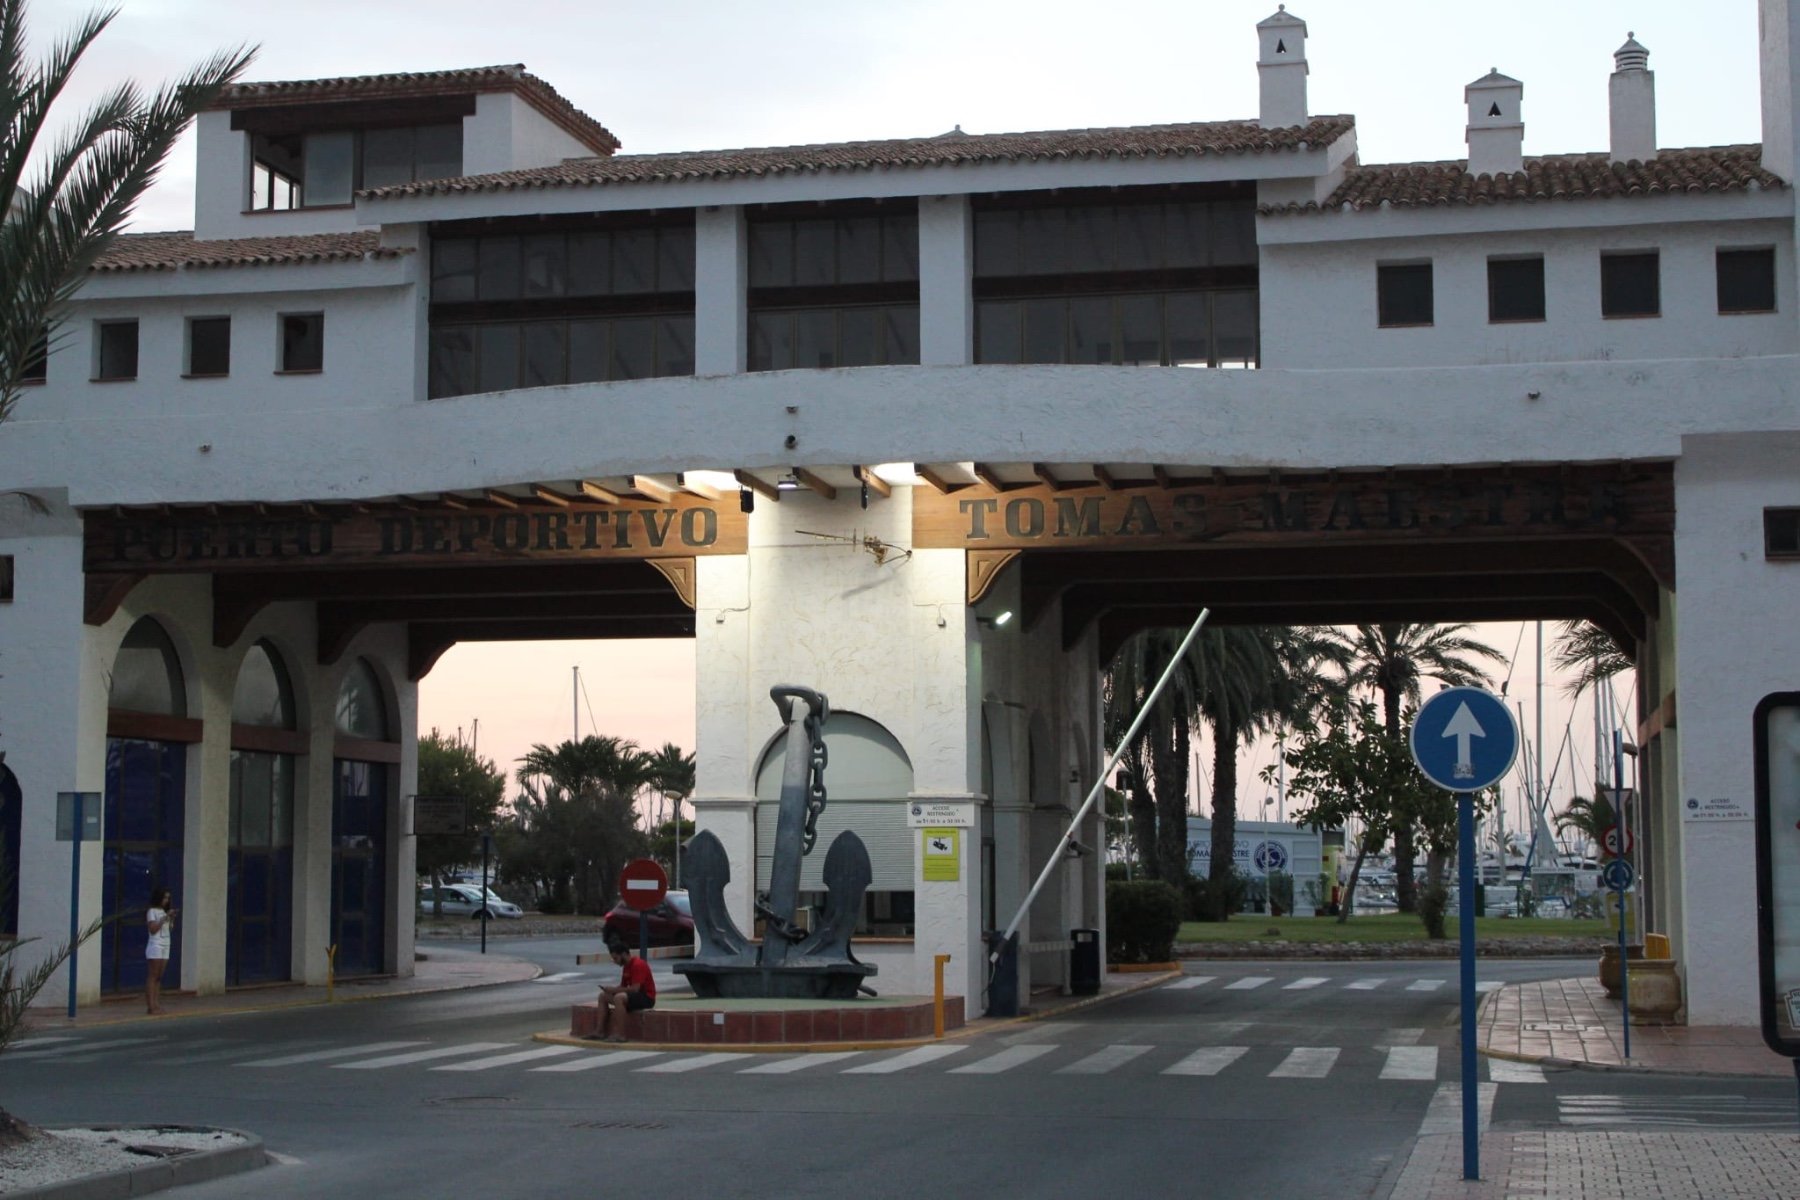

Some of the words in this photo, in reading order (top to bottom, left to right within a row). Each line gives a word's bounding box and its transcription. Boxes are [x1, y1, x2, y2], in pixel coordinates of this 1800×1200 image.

[112, 518, 333, 561] PUERTO
[376, 507, 718, 555] DEPORTIVO
[959, 497, 1209, 539] TOMAS
